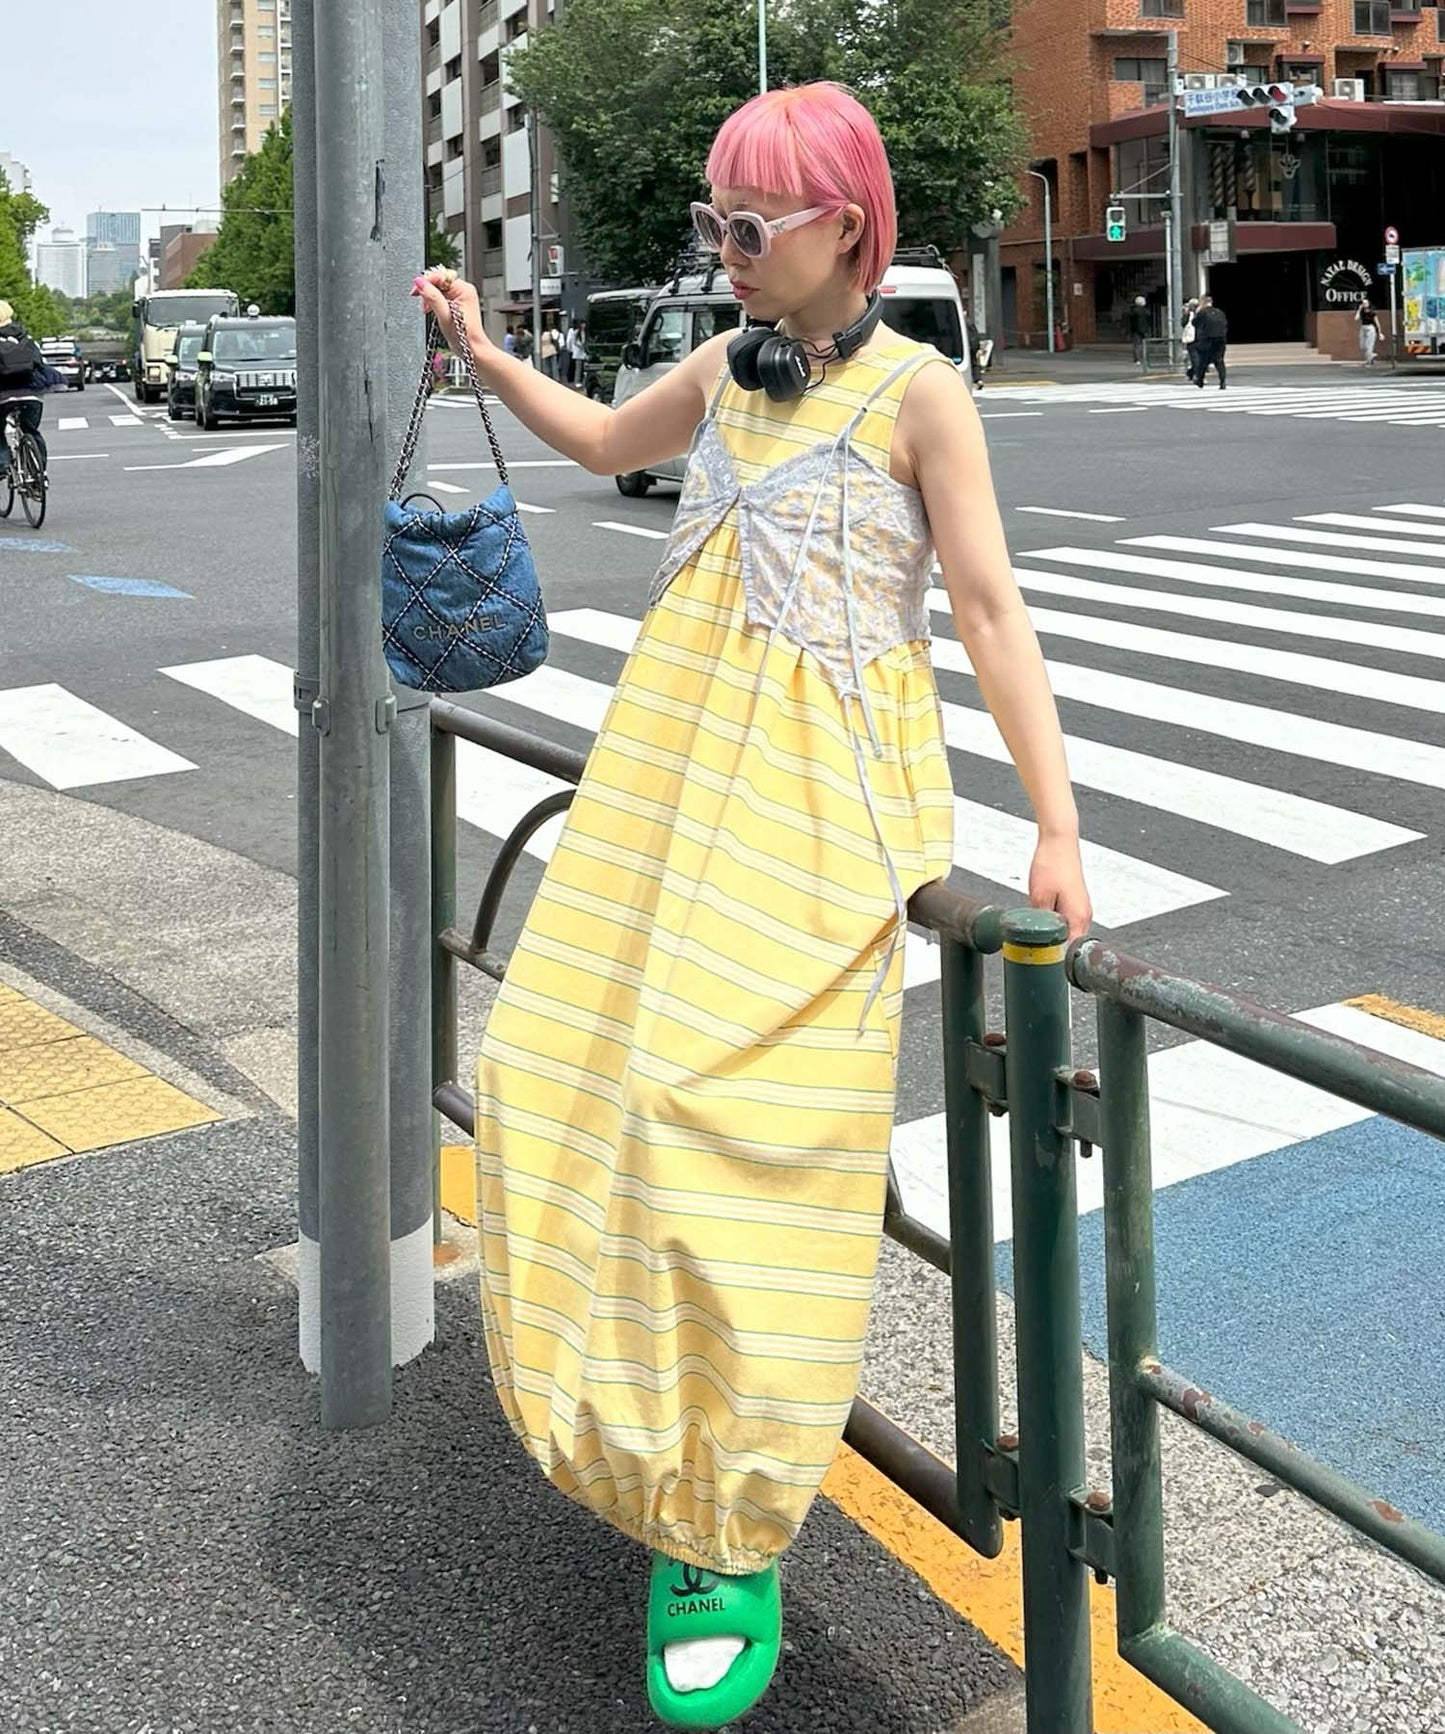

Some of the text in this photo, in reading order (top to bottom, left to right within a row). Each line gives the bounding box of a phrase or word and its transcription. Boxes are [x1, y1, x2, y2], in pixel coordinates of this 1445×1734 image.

[1320, 259, 1373, 287] NATAL DESIGN
[1325, 288, 1368, 302] OFFICE
[413, 615, 507, 641] CHANEL
[667, 1597, 726, 1617] CHANEL
